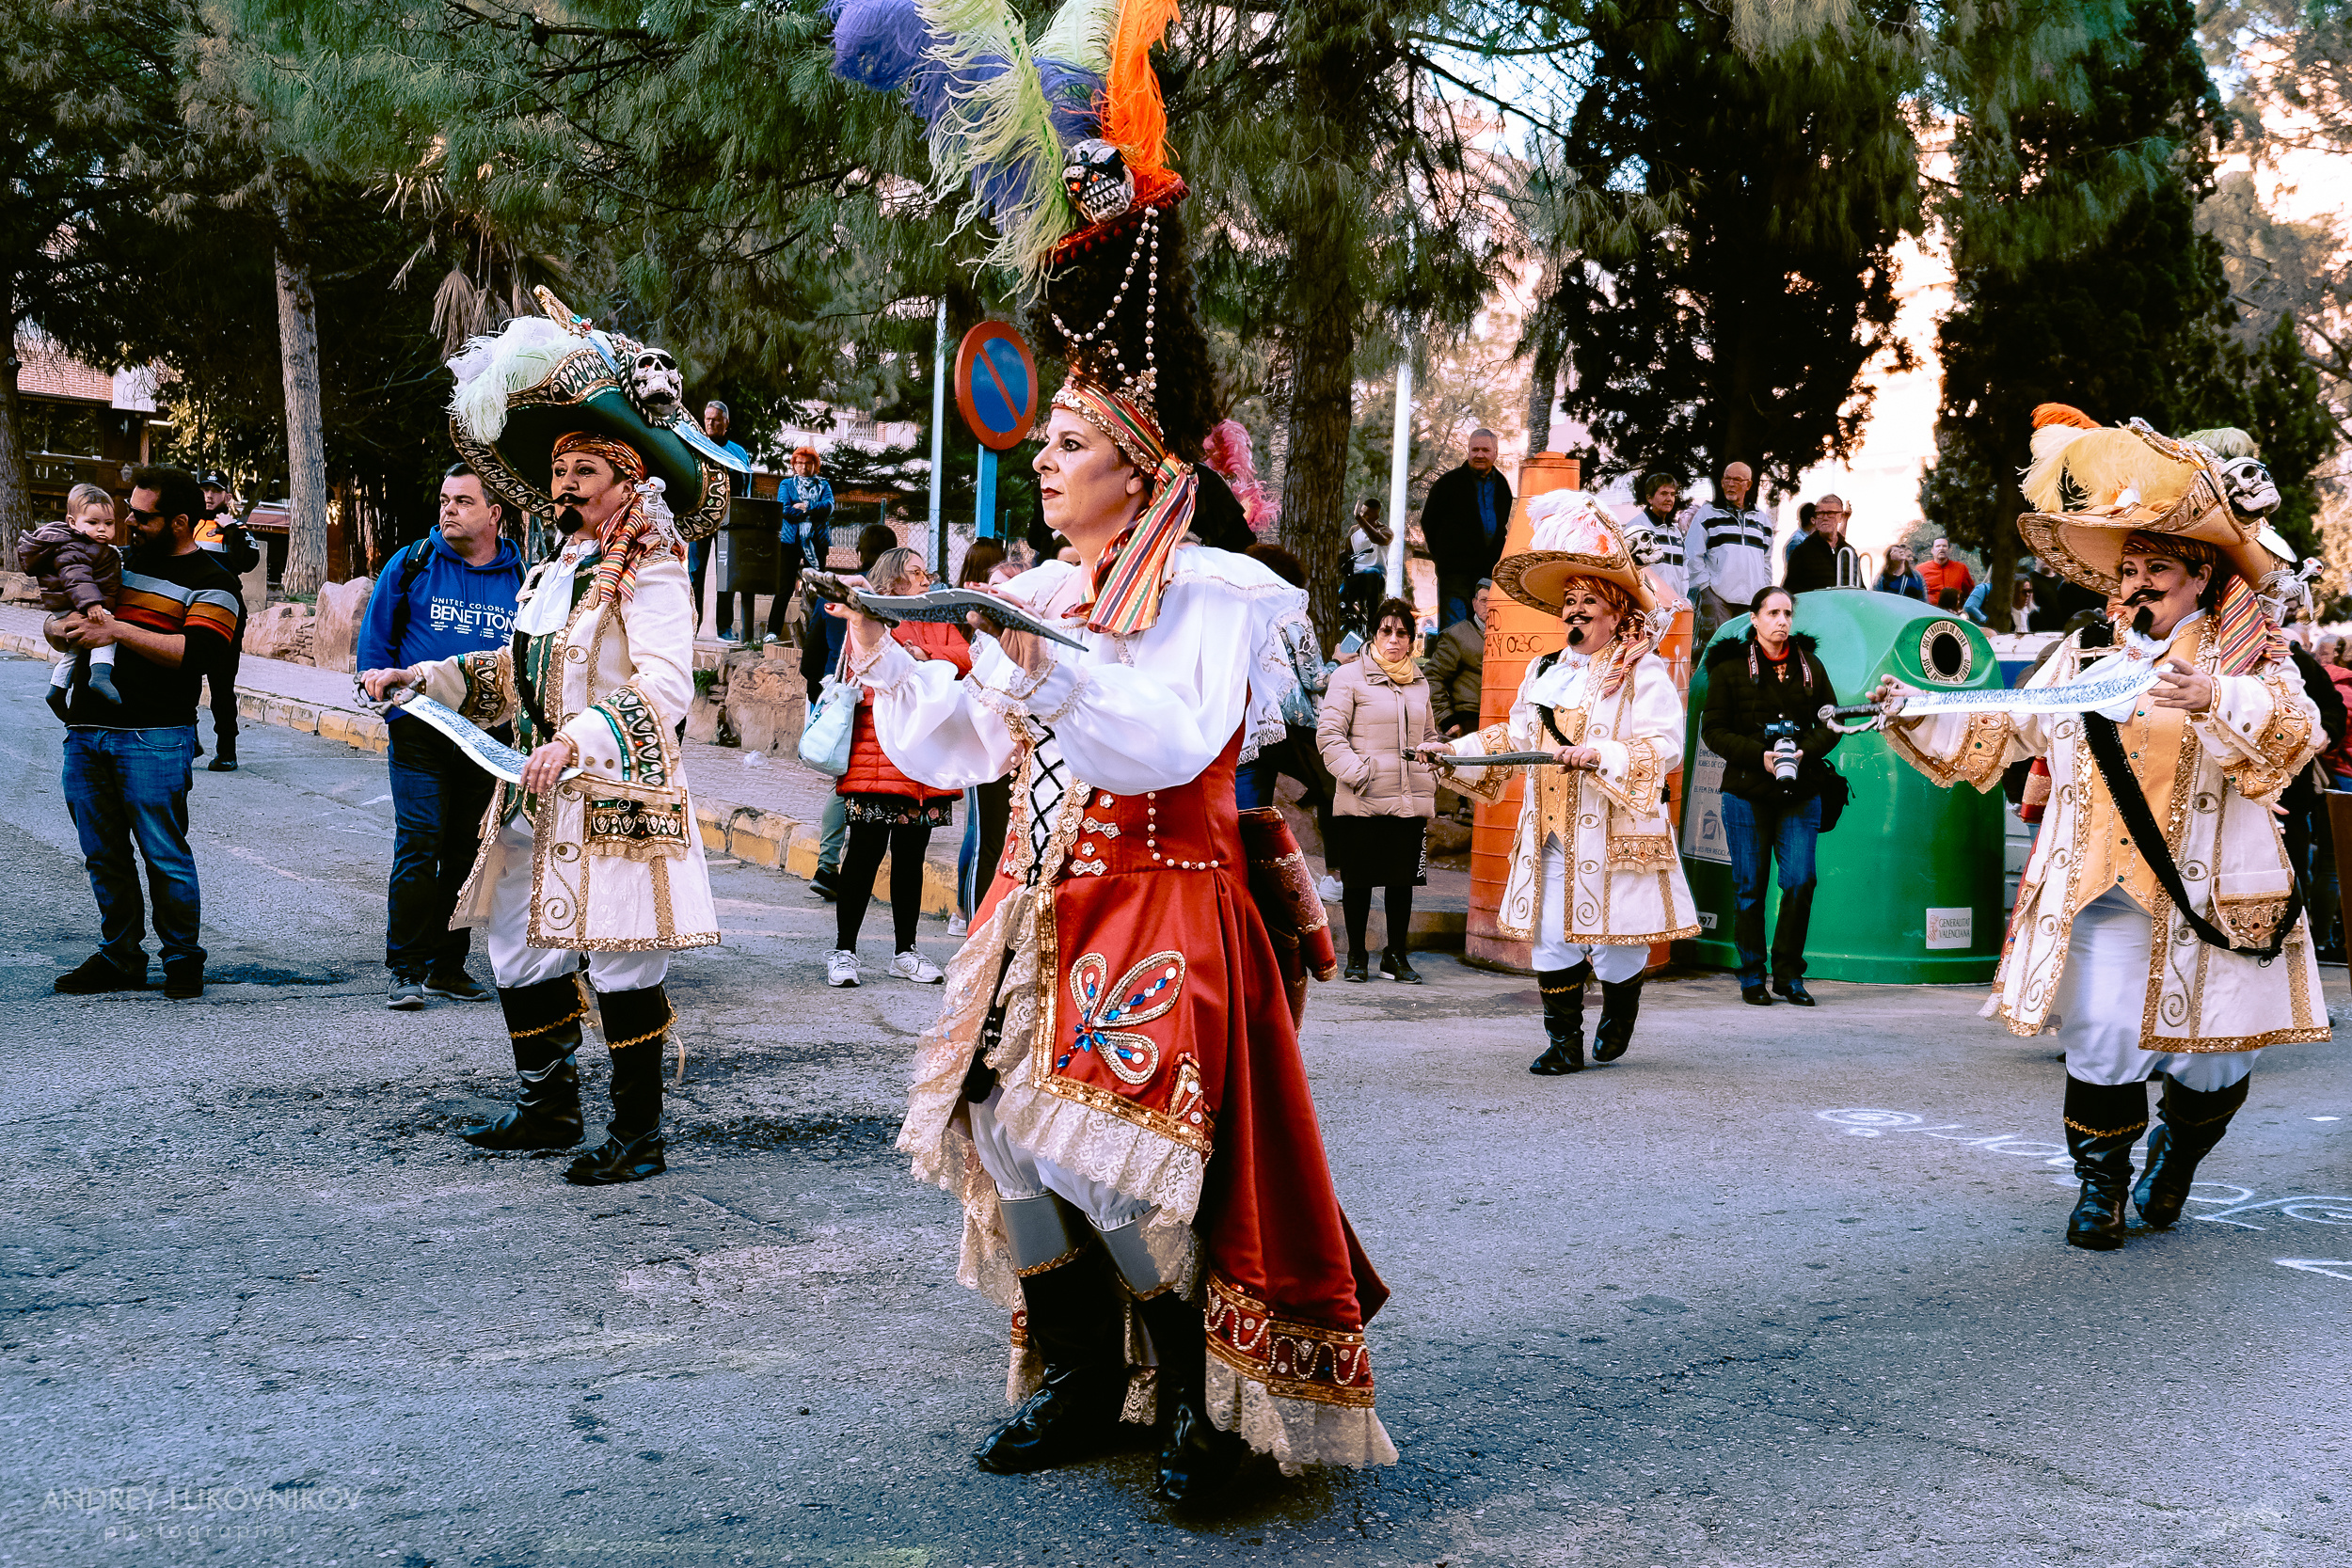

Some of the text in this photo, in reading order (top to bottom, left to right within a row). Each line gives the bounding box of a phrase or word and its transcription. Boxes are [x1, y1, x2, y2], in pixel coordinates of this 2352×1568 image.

[432, 595, 465, 608] UNITED
[469, 603, 505, 614] COLORS
[430, 603, 516, 634] BENETTON
[1938, 917, 1971, 928] GENERALITAT
[1938, 928, 1971, 940] VALENCIANA
